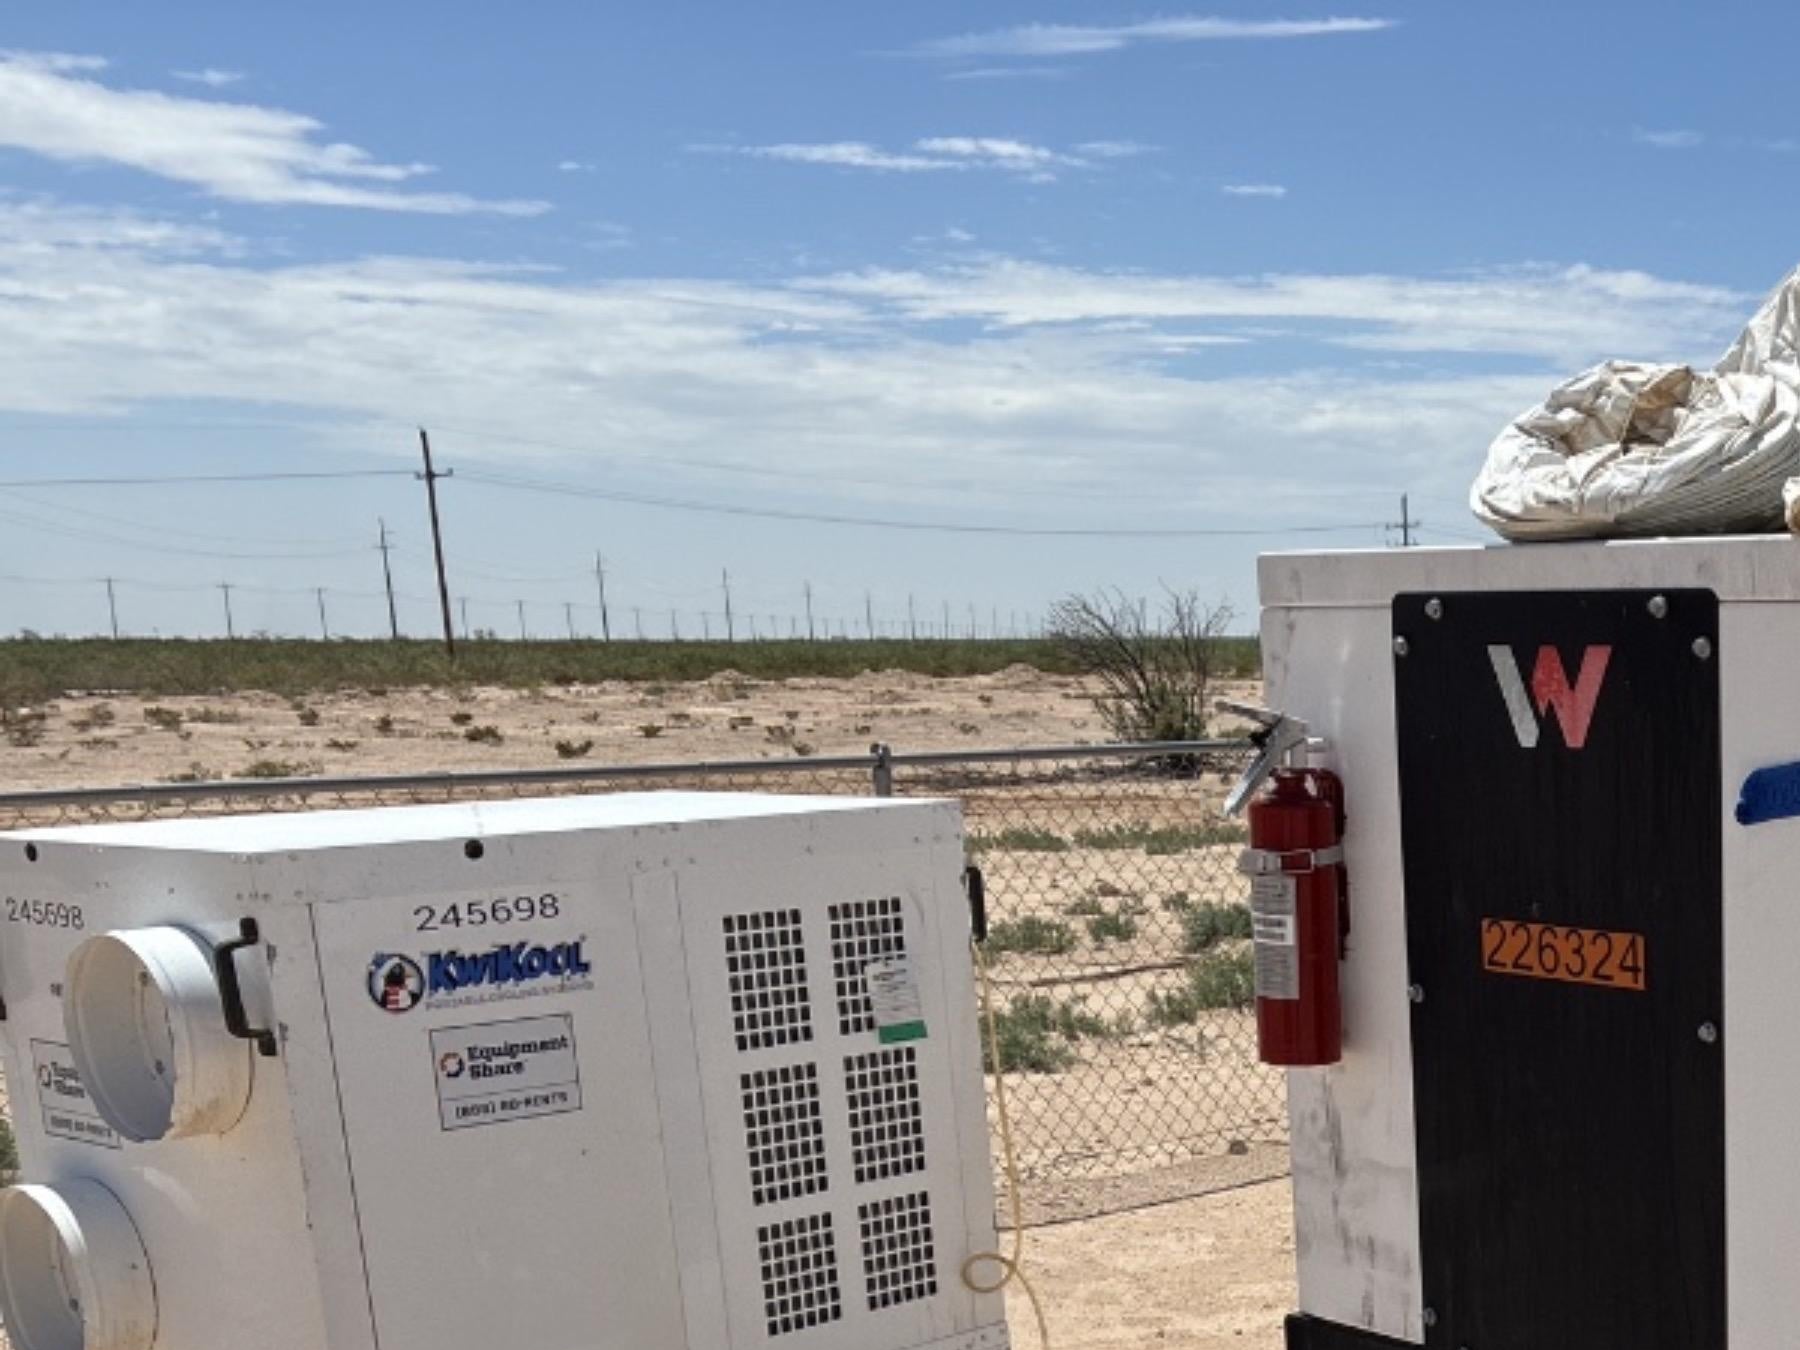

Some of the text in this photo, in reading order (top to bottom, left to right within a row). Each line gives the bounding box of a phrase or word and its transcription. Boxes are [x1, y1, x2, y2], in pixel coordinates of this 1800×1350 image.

[6, 897, 85, 931] 245698
[413, 893, 561, 932] 245698
[1485, 919, 1642, 985] 226324
[466, 1034, 569, 1061] Equipment
[468, 1060, 525, 1081] Share
